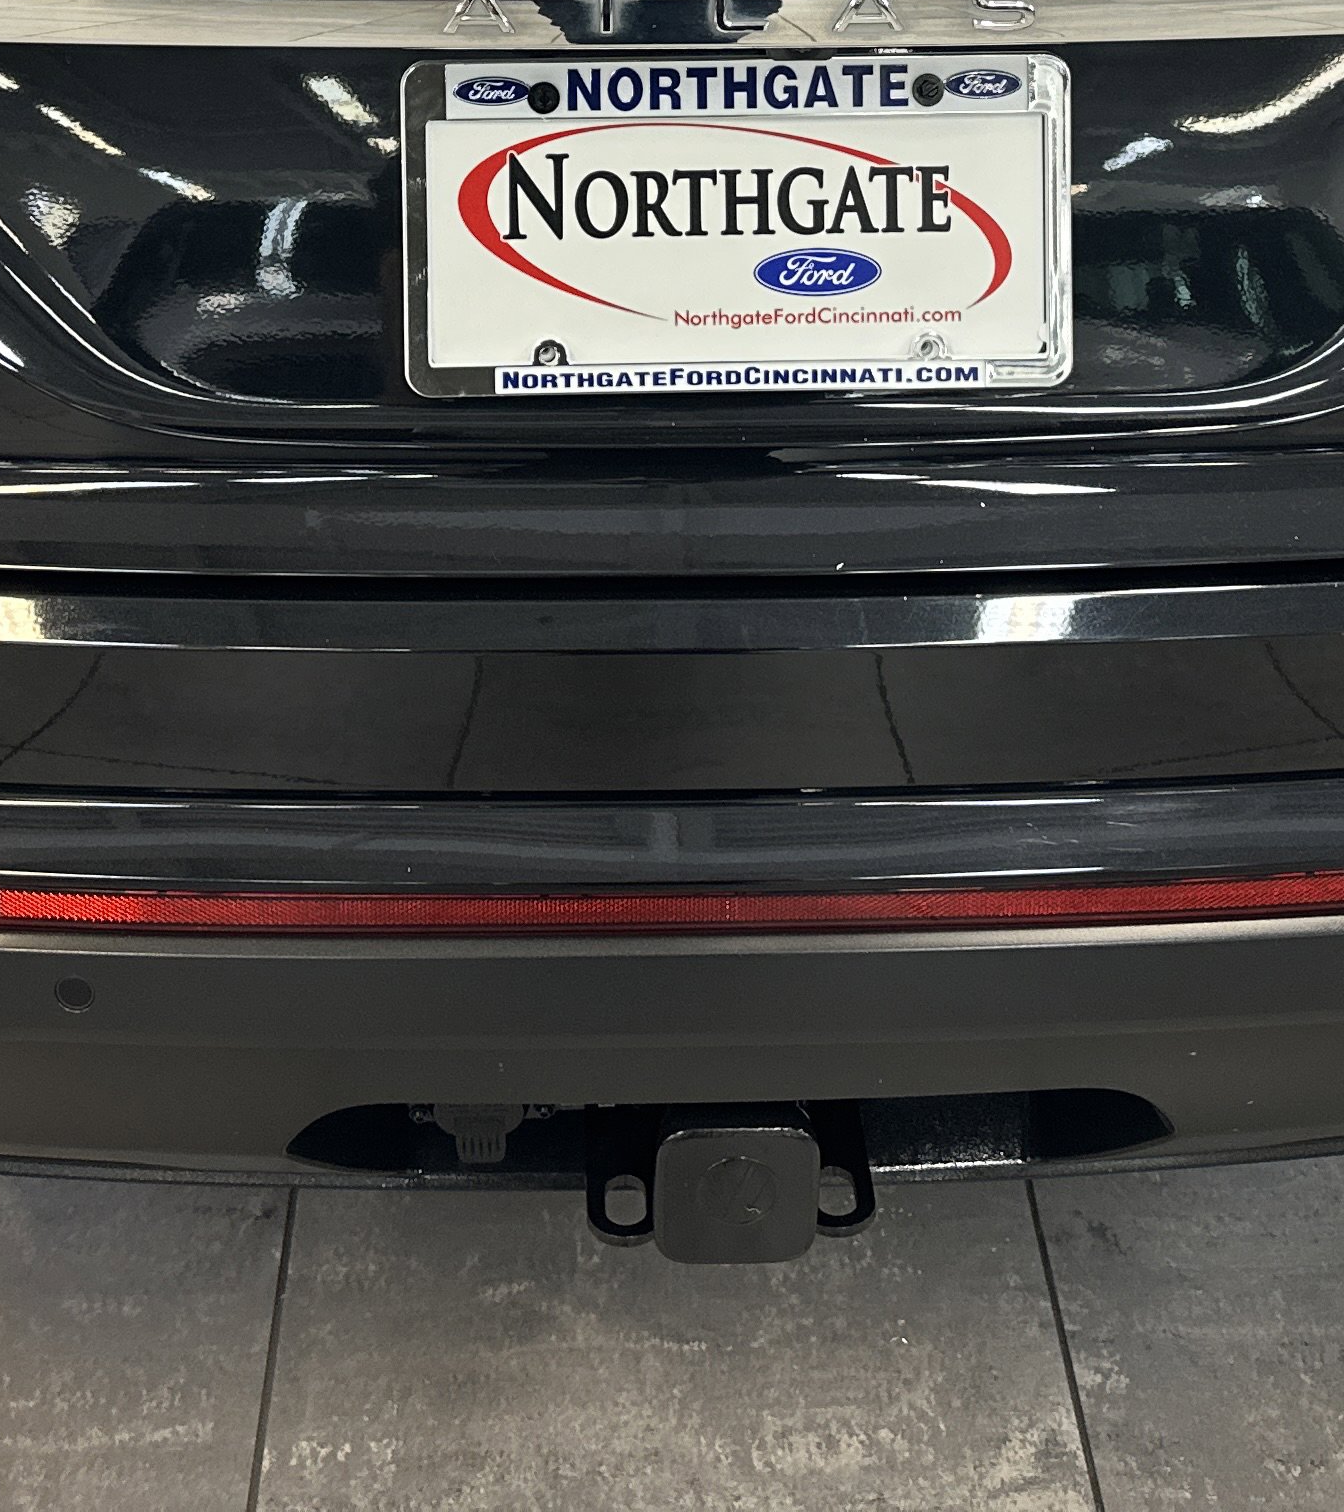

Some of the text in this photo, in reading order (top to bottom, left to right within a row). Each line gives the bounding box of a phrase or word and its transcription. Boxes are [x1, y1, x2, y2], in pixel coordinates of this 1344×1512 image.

[567, 65, 909, 111] NORTHGATE
[502, 152, 952, 241] NORTHGATE
[674, 306, 962, 329] NorthgateFordCincinnati.com
[502, 364, 980, 390] NORTHGATEFORDCINCINNATI.COM
